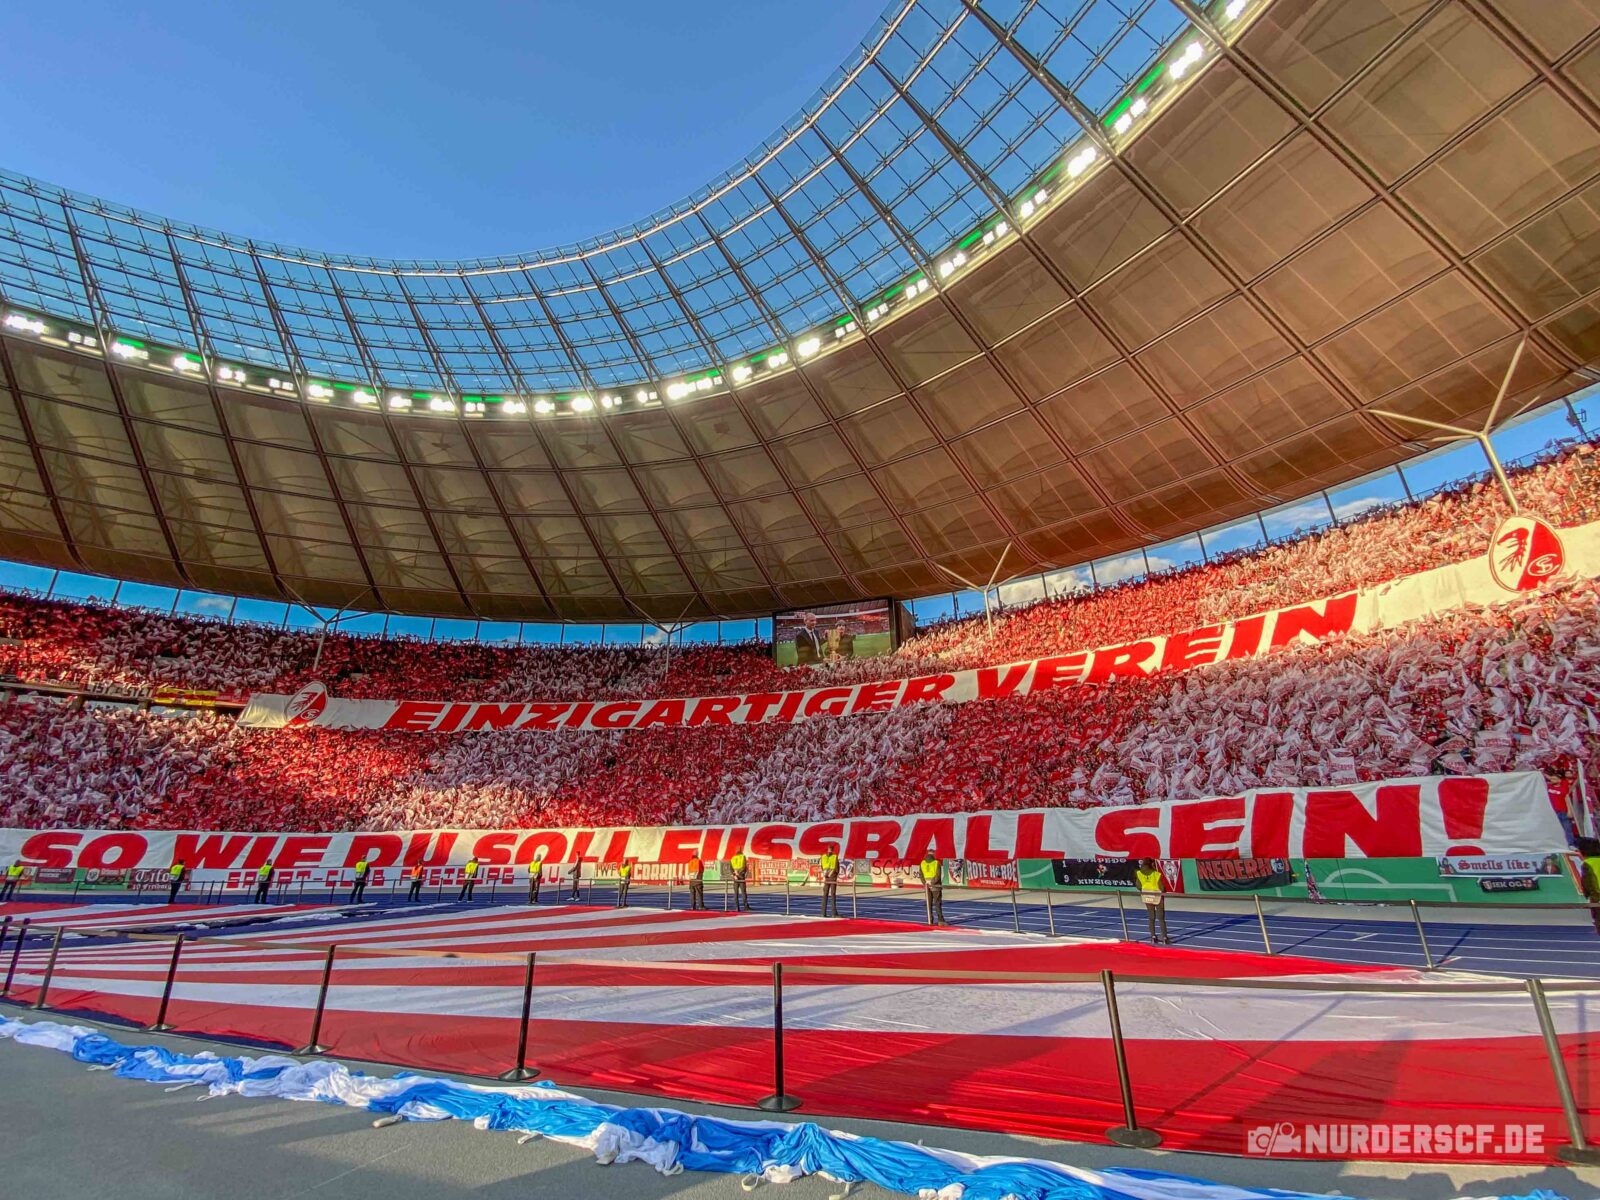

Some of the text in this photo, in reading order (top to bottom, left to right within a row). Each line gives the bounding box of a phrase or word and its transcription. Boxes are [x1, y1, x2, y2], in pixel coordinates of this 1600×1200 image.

[384, 592, 1358, 732] EINZIGARTIGER VEREIN
[21, 777, 1489, 869] SO WIE DU SOLL FUSSBALL SEIN!
[966, 860, 988, 880] ROTE
[1458, 859, 1530, 871] Smells like
